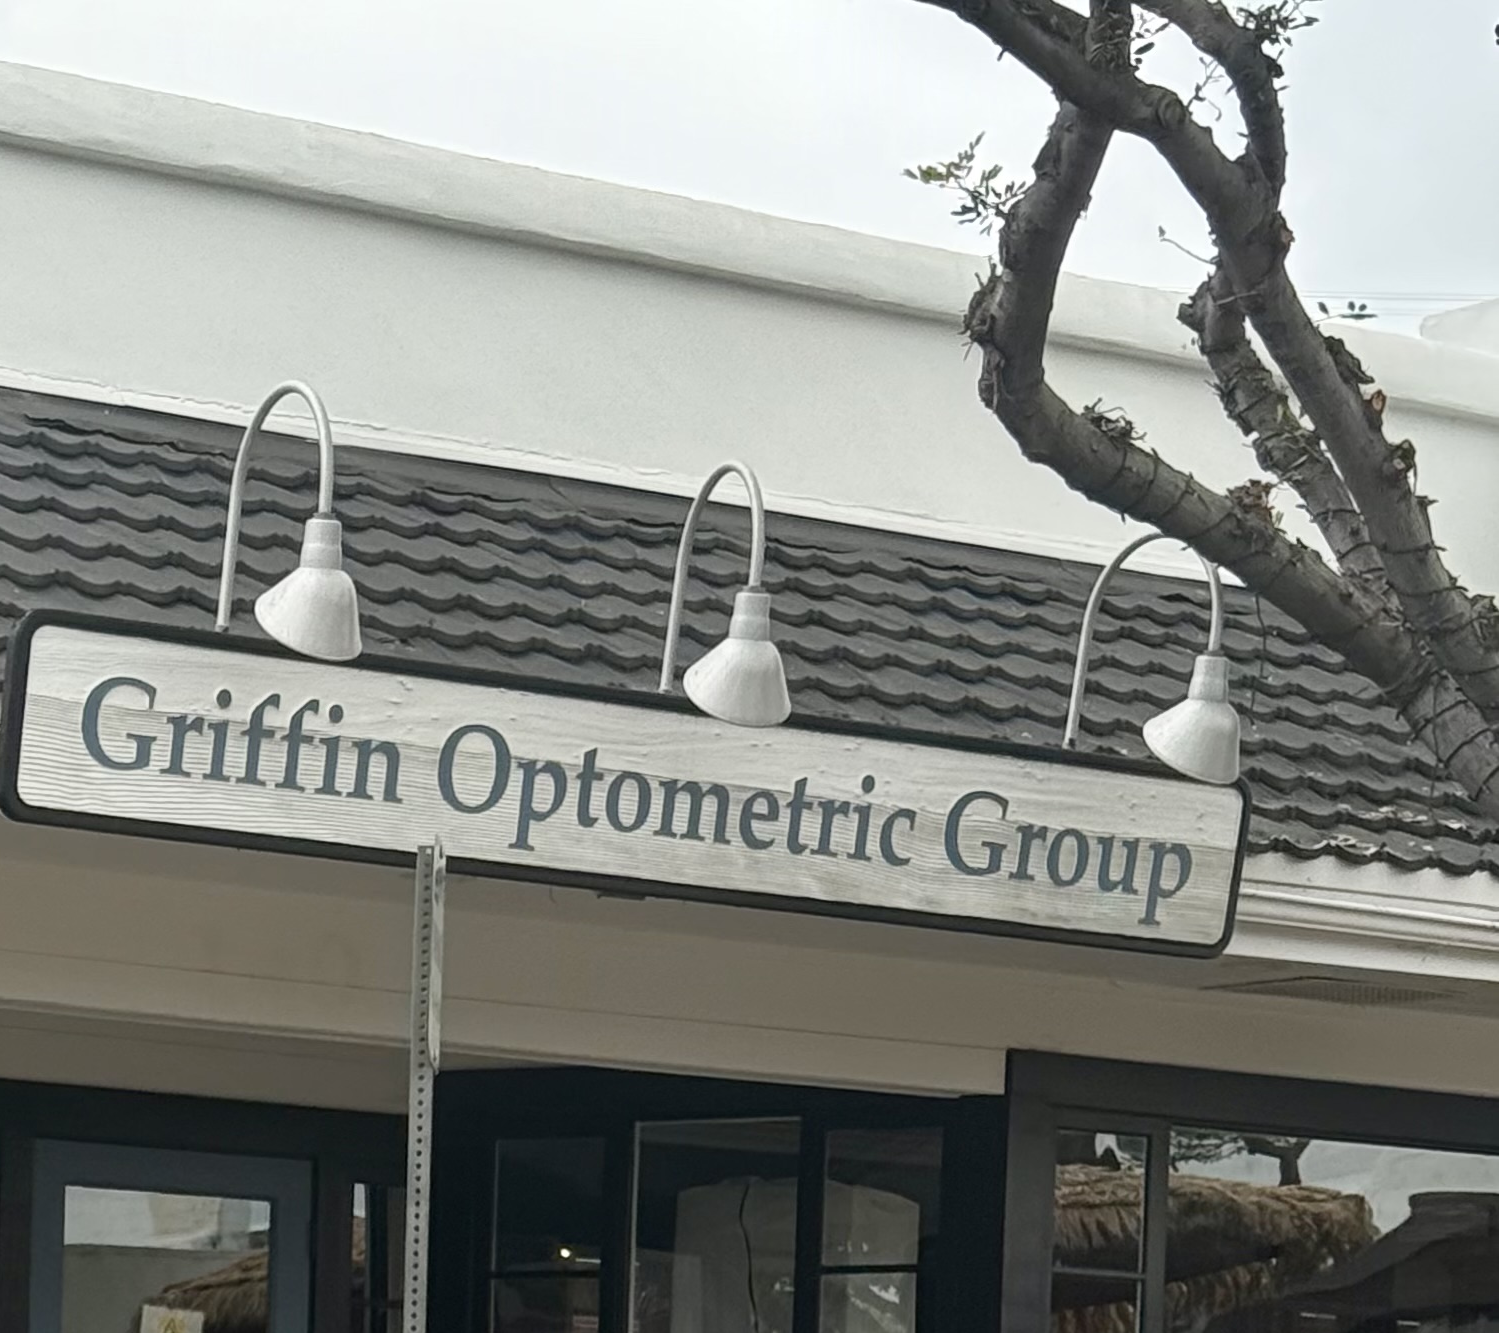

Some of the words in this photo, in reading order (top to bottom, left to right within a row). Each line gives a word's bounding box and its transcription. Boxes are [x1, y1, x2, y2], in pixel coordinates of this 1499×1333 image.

[80, 675, 404, 804] Griffin
[437, 722, 917, 868] Optometric
[942, 789, 1192, 927] Group
